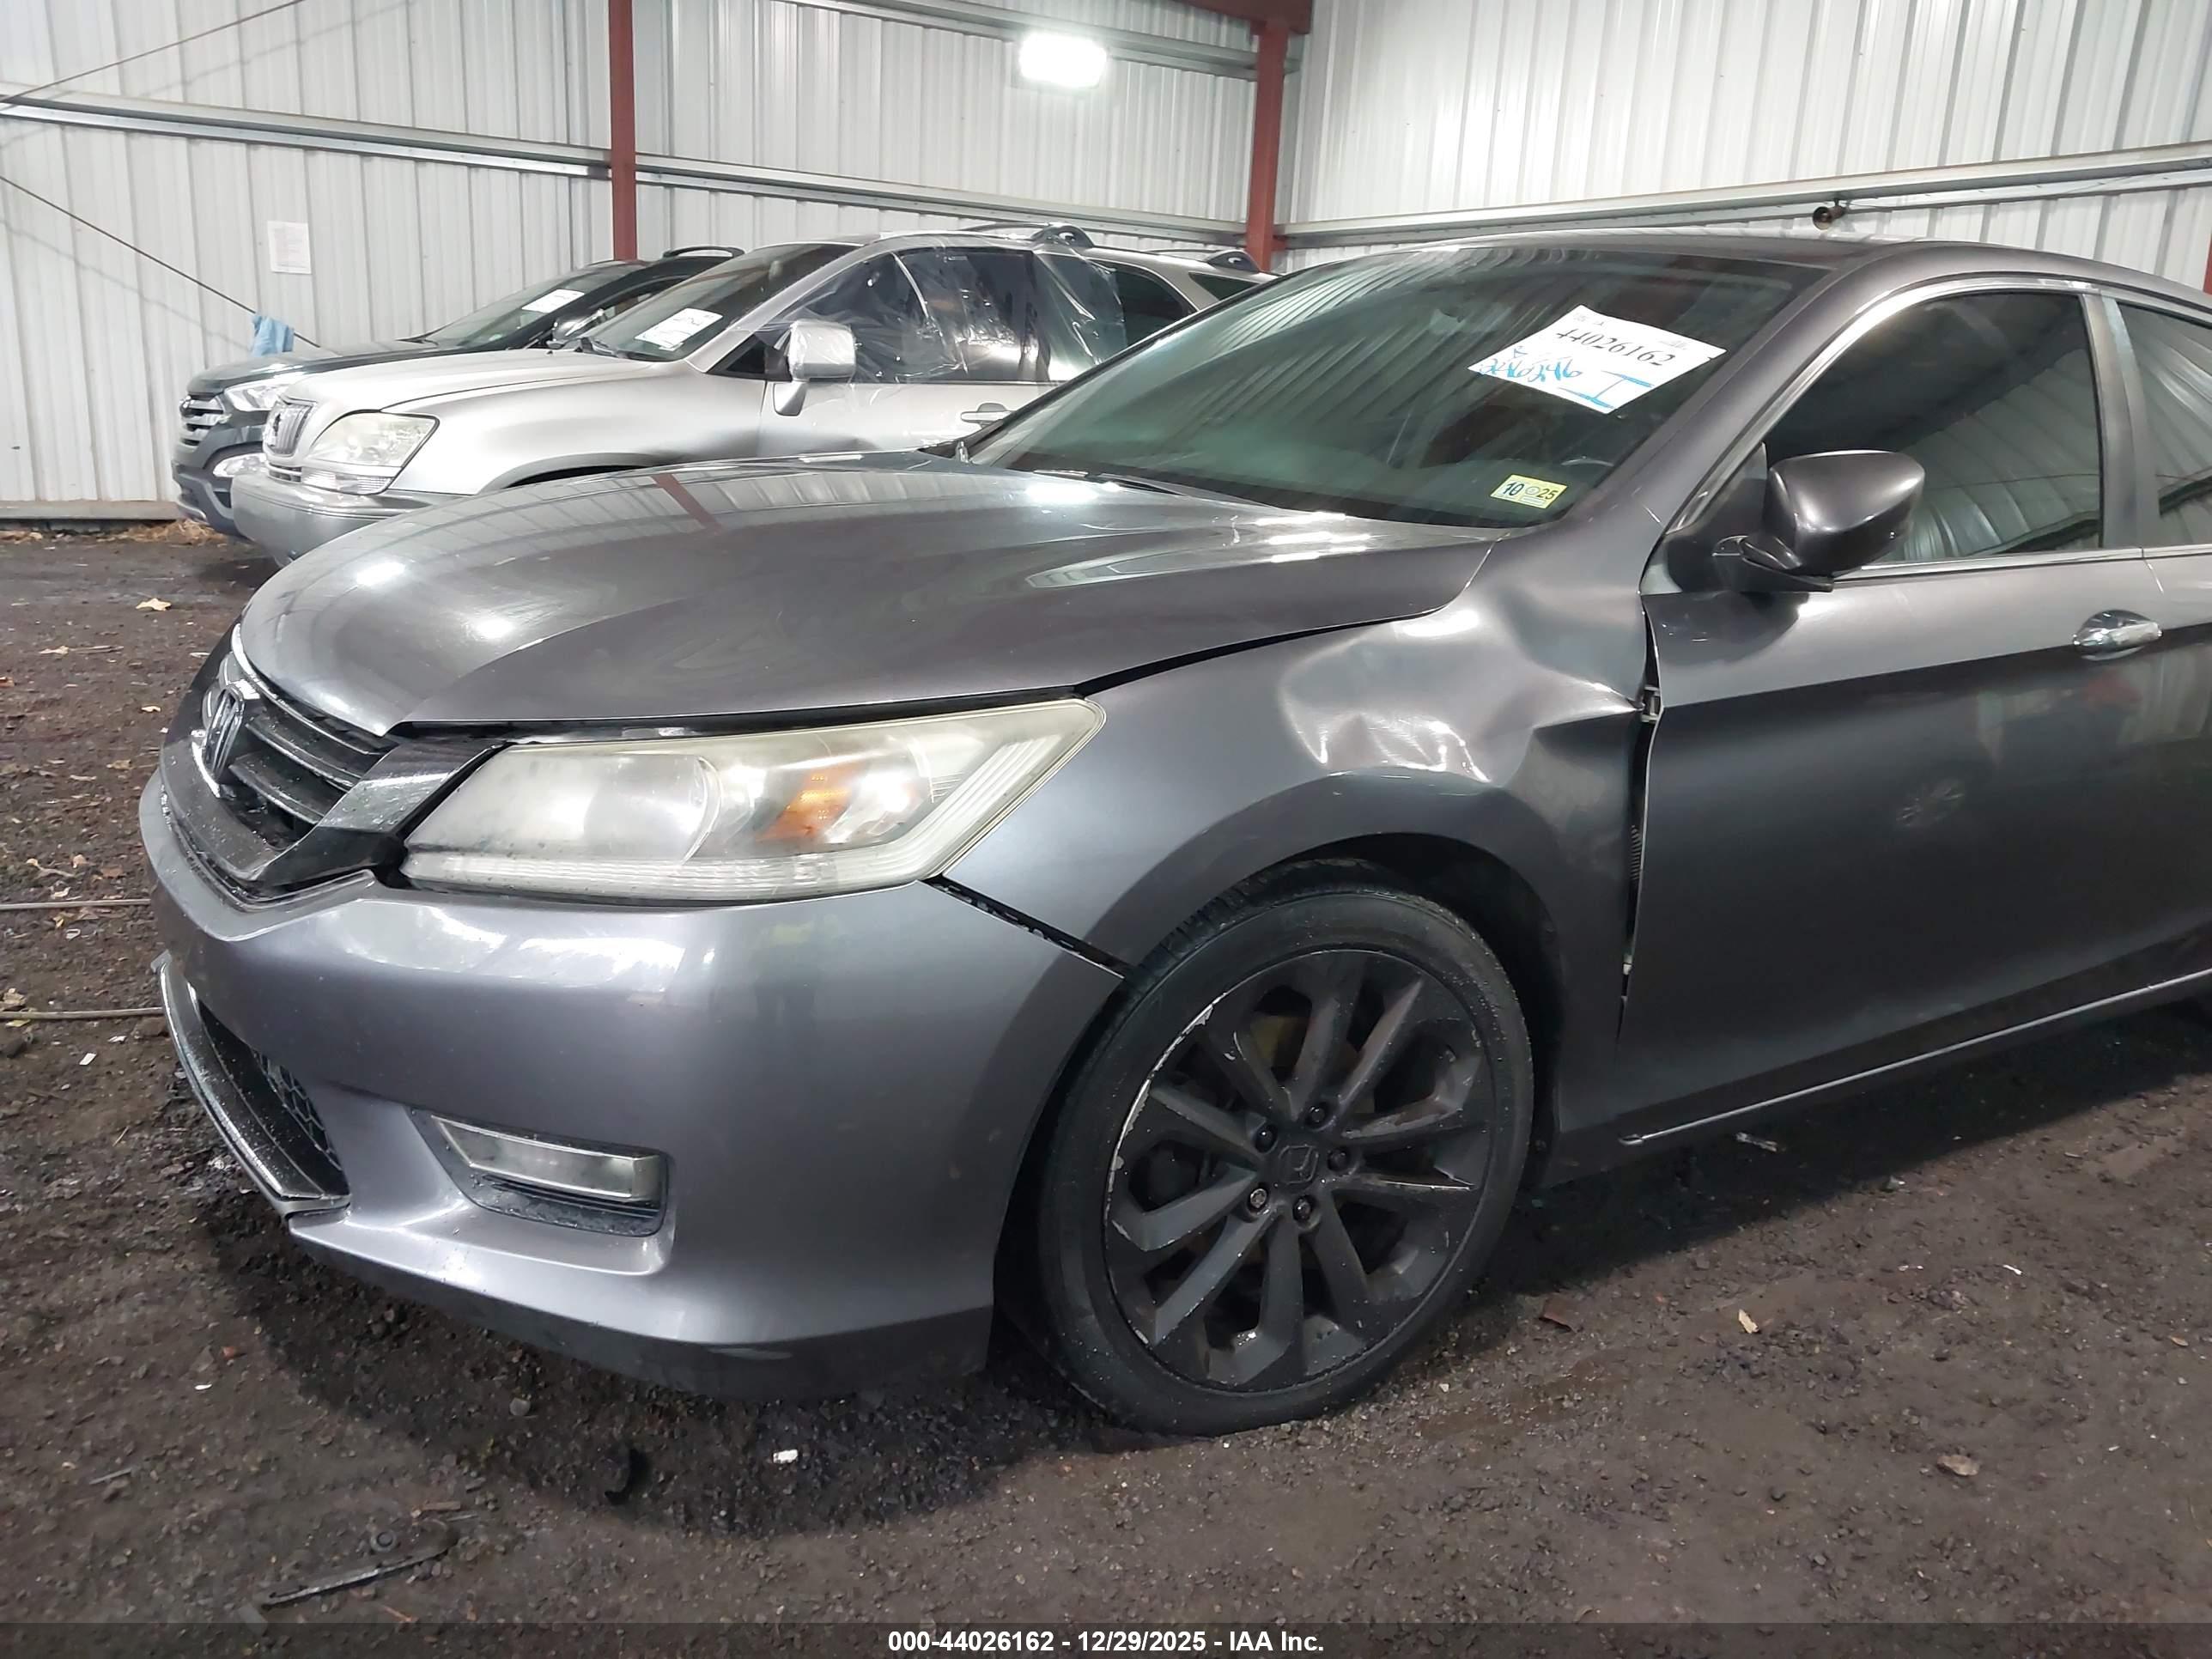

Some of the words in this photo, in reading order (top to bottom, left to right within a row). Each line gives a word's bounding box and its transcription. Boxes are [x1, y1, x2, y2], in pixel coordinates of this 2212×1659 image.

[1556, 327, 1676, 367] 44026162
[1503, 482, 1525, 496] 10
[1536, 488, 1559, 500] 25
